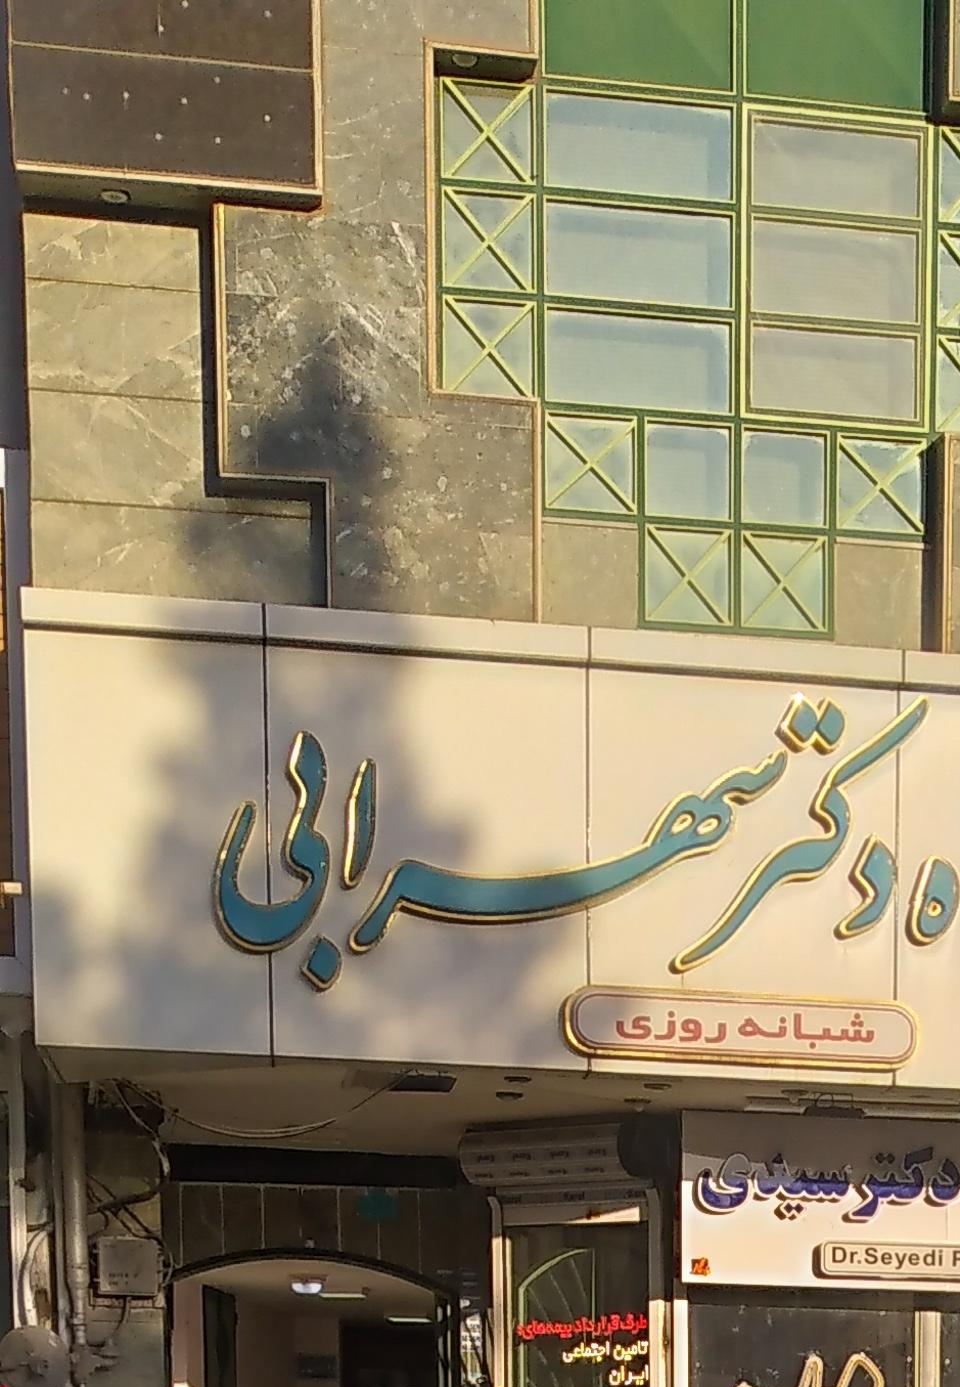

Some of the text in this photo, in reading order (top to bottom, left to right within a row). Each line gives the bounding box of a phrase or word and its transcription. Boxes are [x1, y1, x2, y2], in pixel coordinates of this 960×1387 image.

[668, 691, 929, 976] دکتر
[210, 728, 788, 992] سهرابی
[615, 1010, 876, 1050] شبانه روزی
[695, 1152, 850, 1222] سیدی
[831, 1246, 944, 1272] Dr.Seyedi
[574, 1314, 621, 1336] قرارداد
[620, 1312, 648, 1334] طرف
[562, 1340, 649, 1363] تامین اجتماعی
[608, 1364, 649, 1386] ایران
